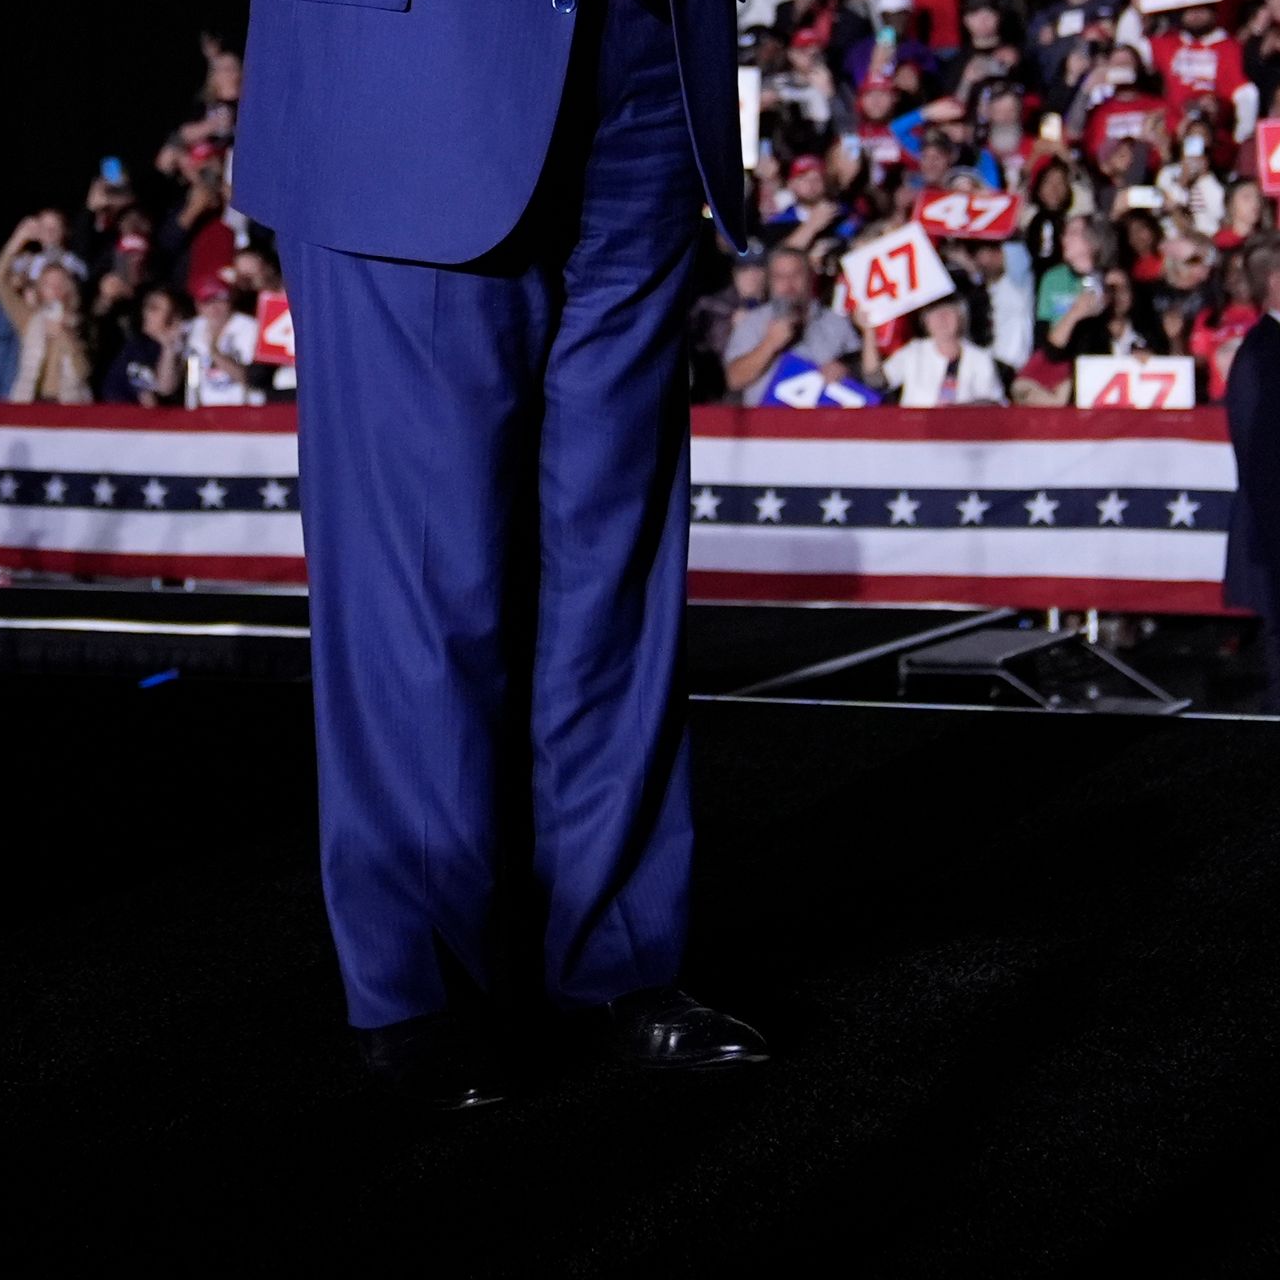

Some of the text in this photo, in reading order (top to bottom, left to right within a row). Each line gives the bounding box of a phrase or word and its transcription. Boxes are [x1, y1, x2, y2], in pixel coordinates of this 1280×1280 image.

[923, 193, 1012, 231] 47
[865, 242, 919, 299] 47
[263, 309, 295, 356] 4
[1092, 372, 1176, 408] 47
